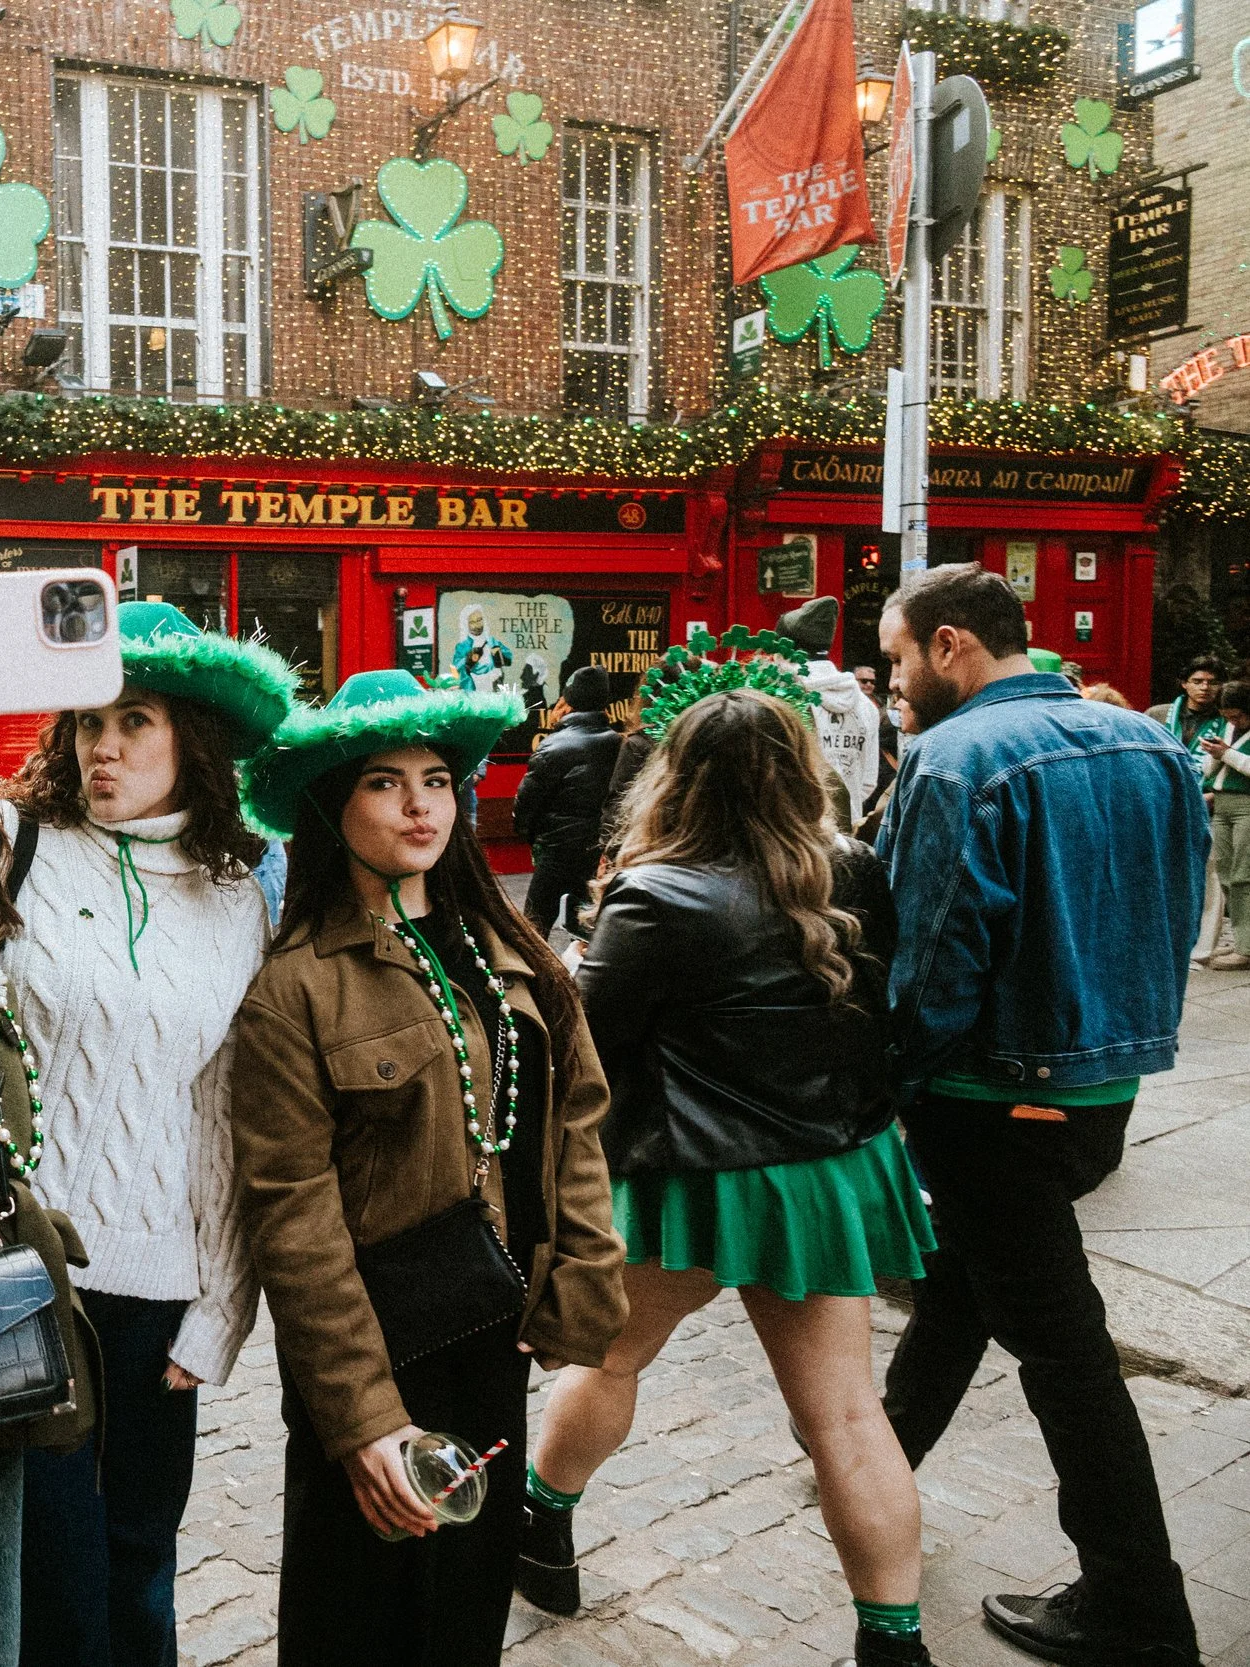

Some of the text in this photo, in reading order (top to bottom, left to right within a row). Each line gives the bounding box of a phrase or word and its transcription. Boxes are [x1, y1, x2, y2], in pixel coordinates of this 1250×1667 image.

[474, 40, 527, 86] AR
[740, 169, 860, 224] TEMPLE
[774, 204, 836, 238] BAR
[1112, 199, 1188, 231] TEMPLE
[1130, 222, 1170, 243] BAR
[1159, 348, 1224, 405] THE
[92, 487, 529, 528] THE TEMPLE BAR
[515, 602, 548, 617] THE
[500, 618, 562, 634] TEMPLE
[515, 634, 549, 650] BAR
[627, 630, 659, 650] THE
